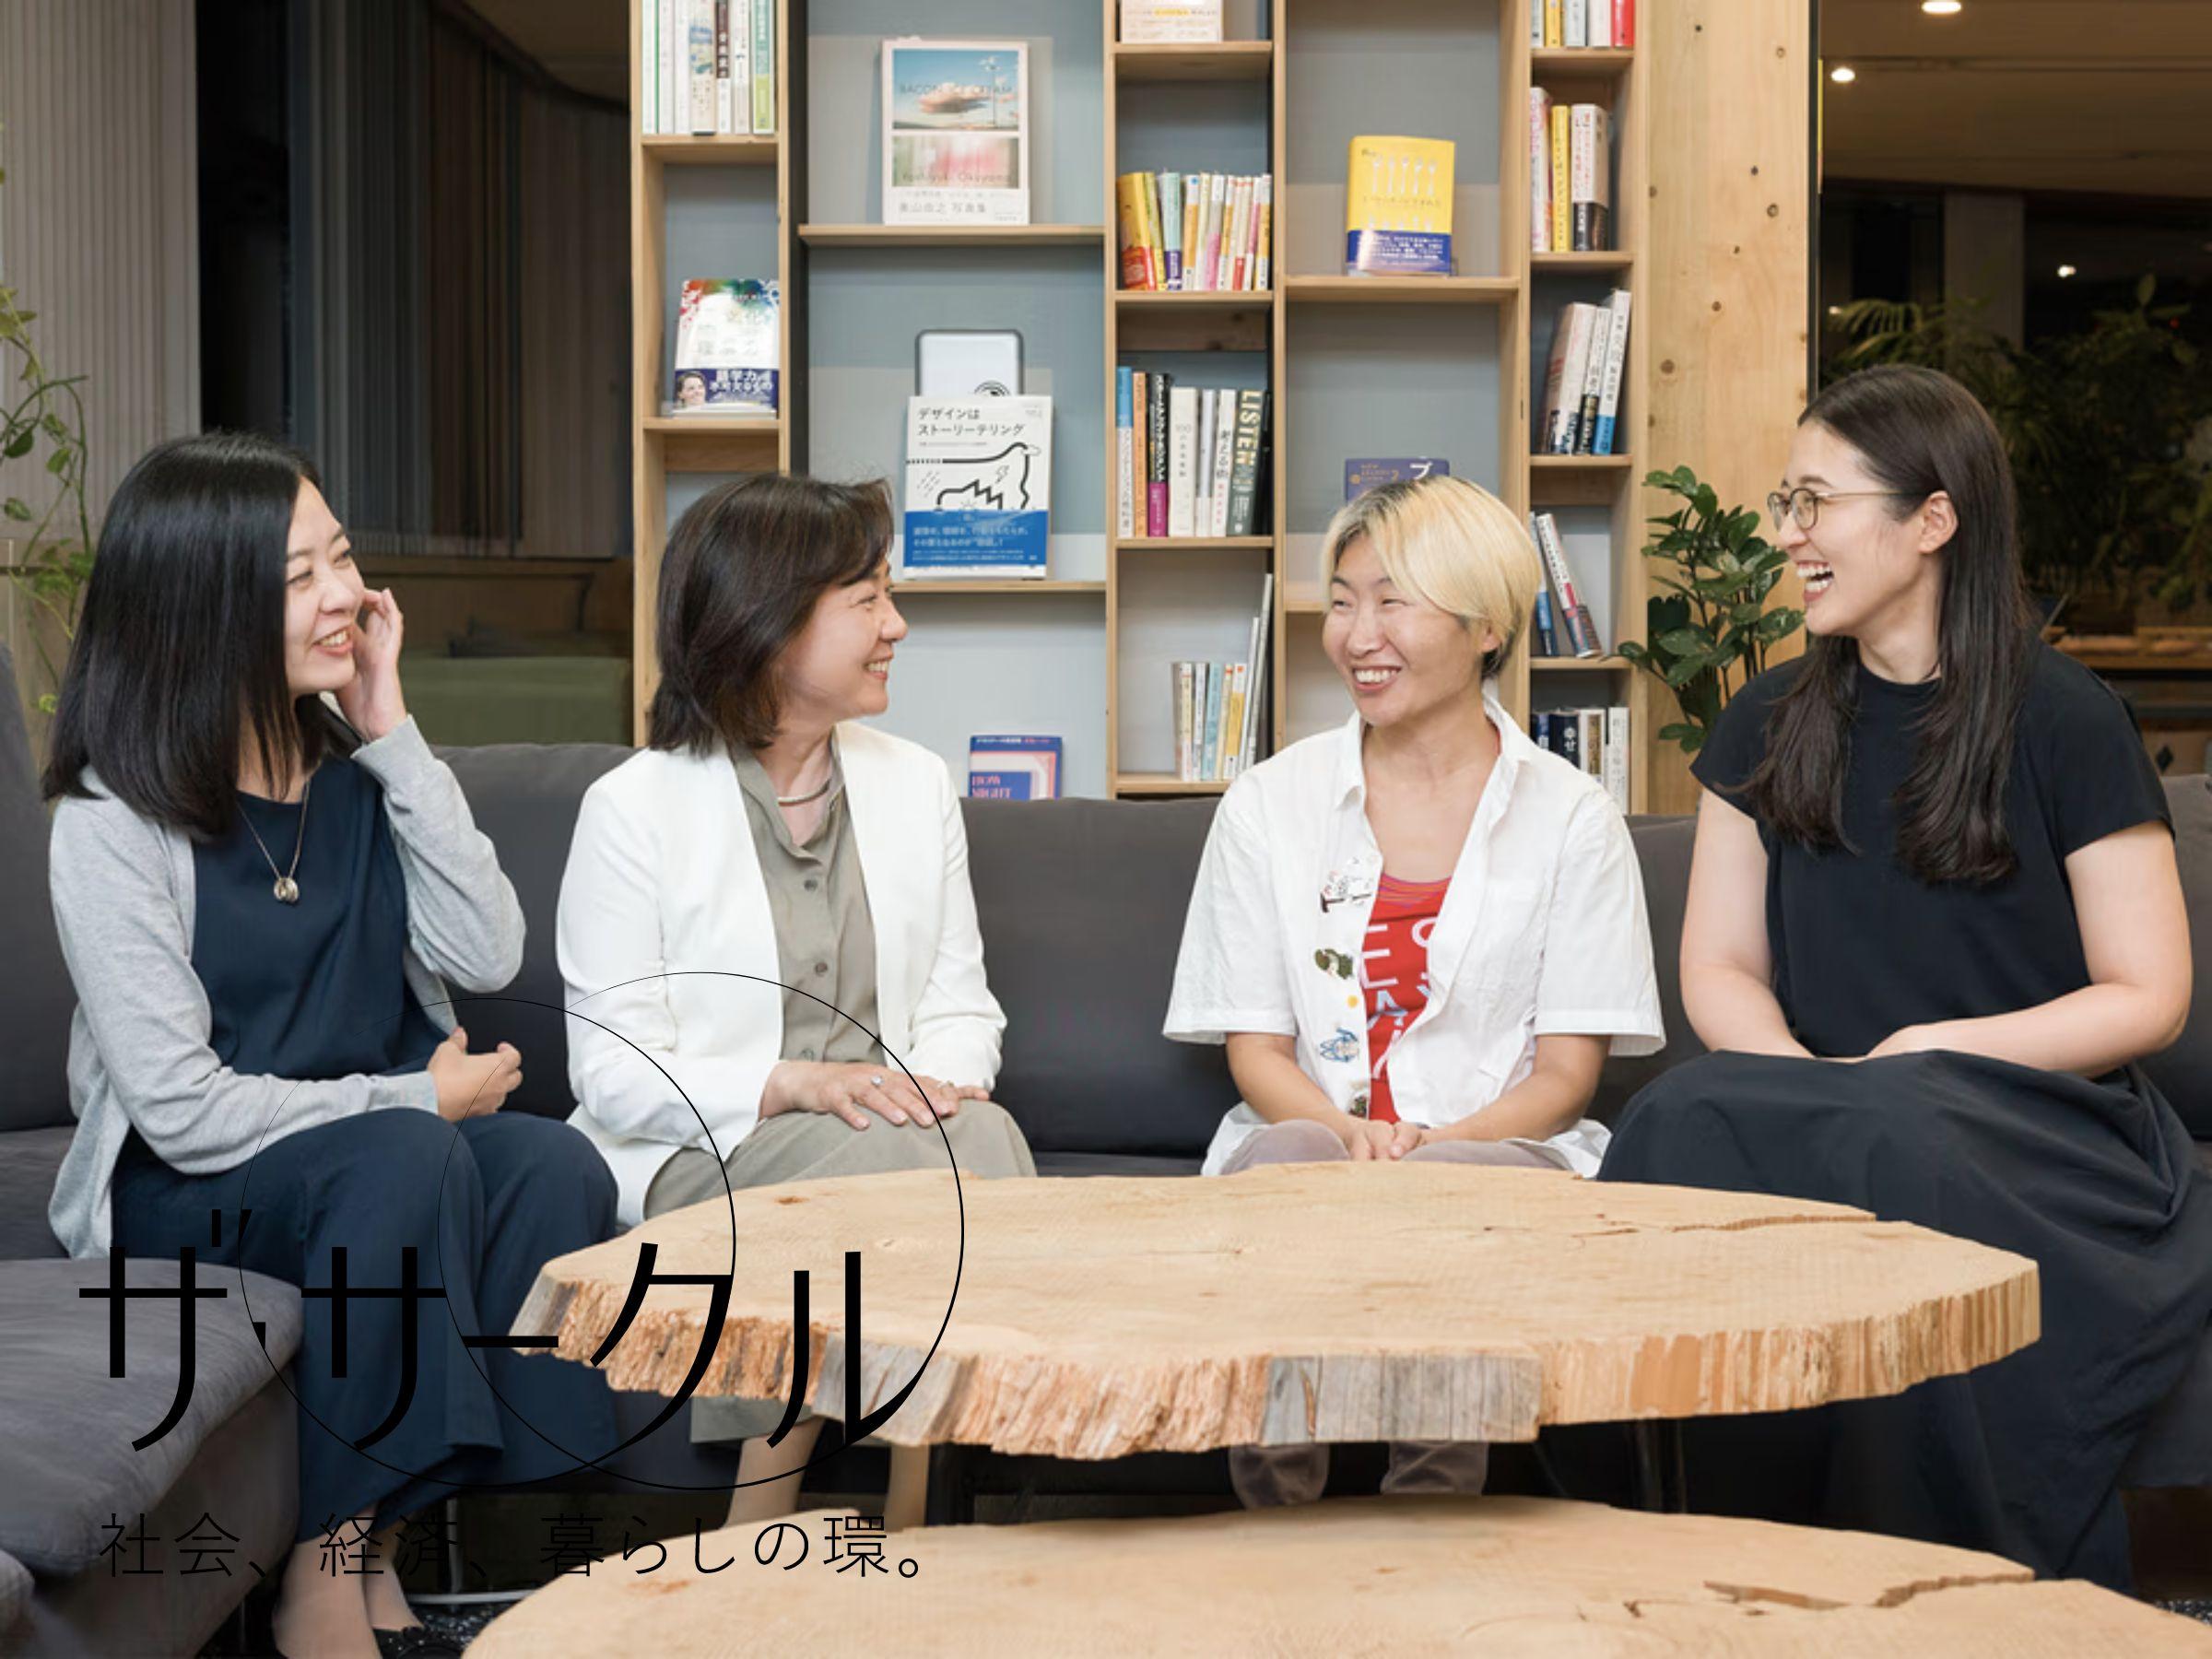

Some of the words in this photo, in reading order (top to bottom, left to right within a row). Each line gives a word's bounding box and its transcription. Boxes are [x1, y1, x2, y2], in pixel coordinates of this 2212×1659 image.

[917, 406, 981, 421] デザインは
[917, 423, 1027, 437] ストーリーテリング
